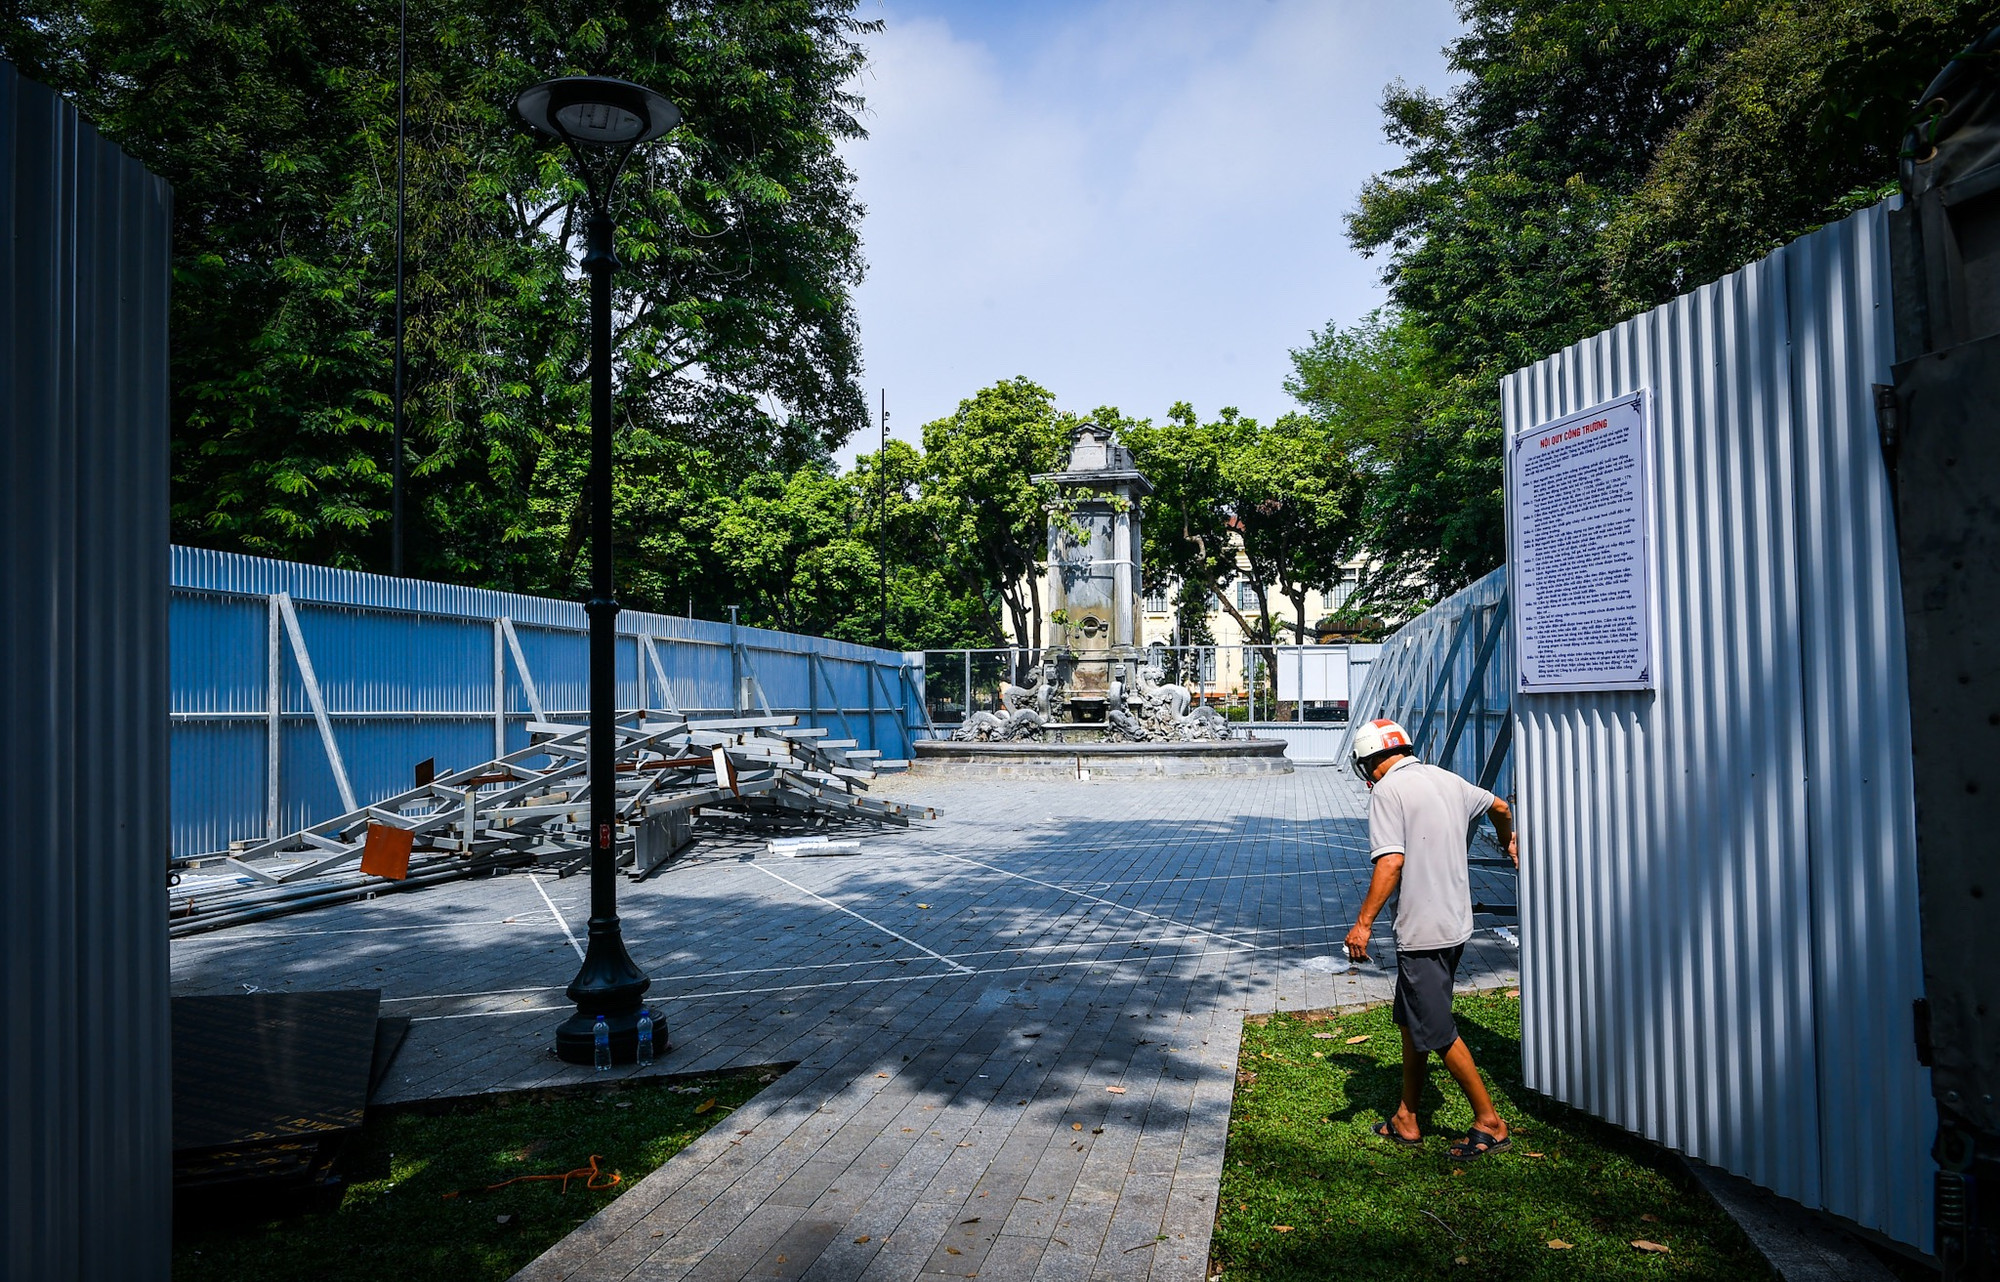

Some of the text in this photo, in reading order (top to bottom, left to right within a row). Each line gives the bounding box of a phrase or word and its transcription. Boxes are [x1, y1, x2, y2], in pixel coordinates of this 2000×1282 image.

[1540, 437, 1550, 449] NỘI
[1551, 433, 1563, 445] QUY
[1564, 428, 1581, 440] CÔNG
